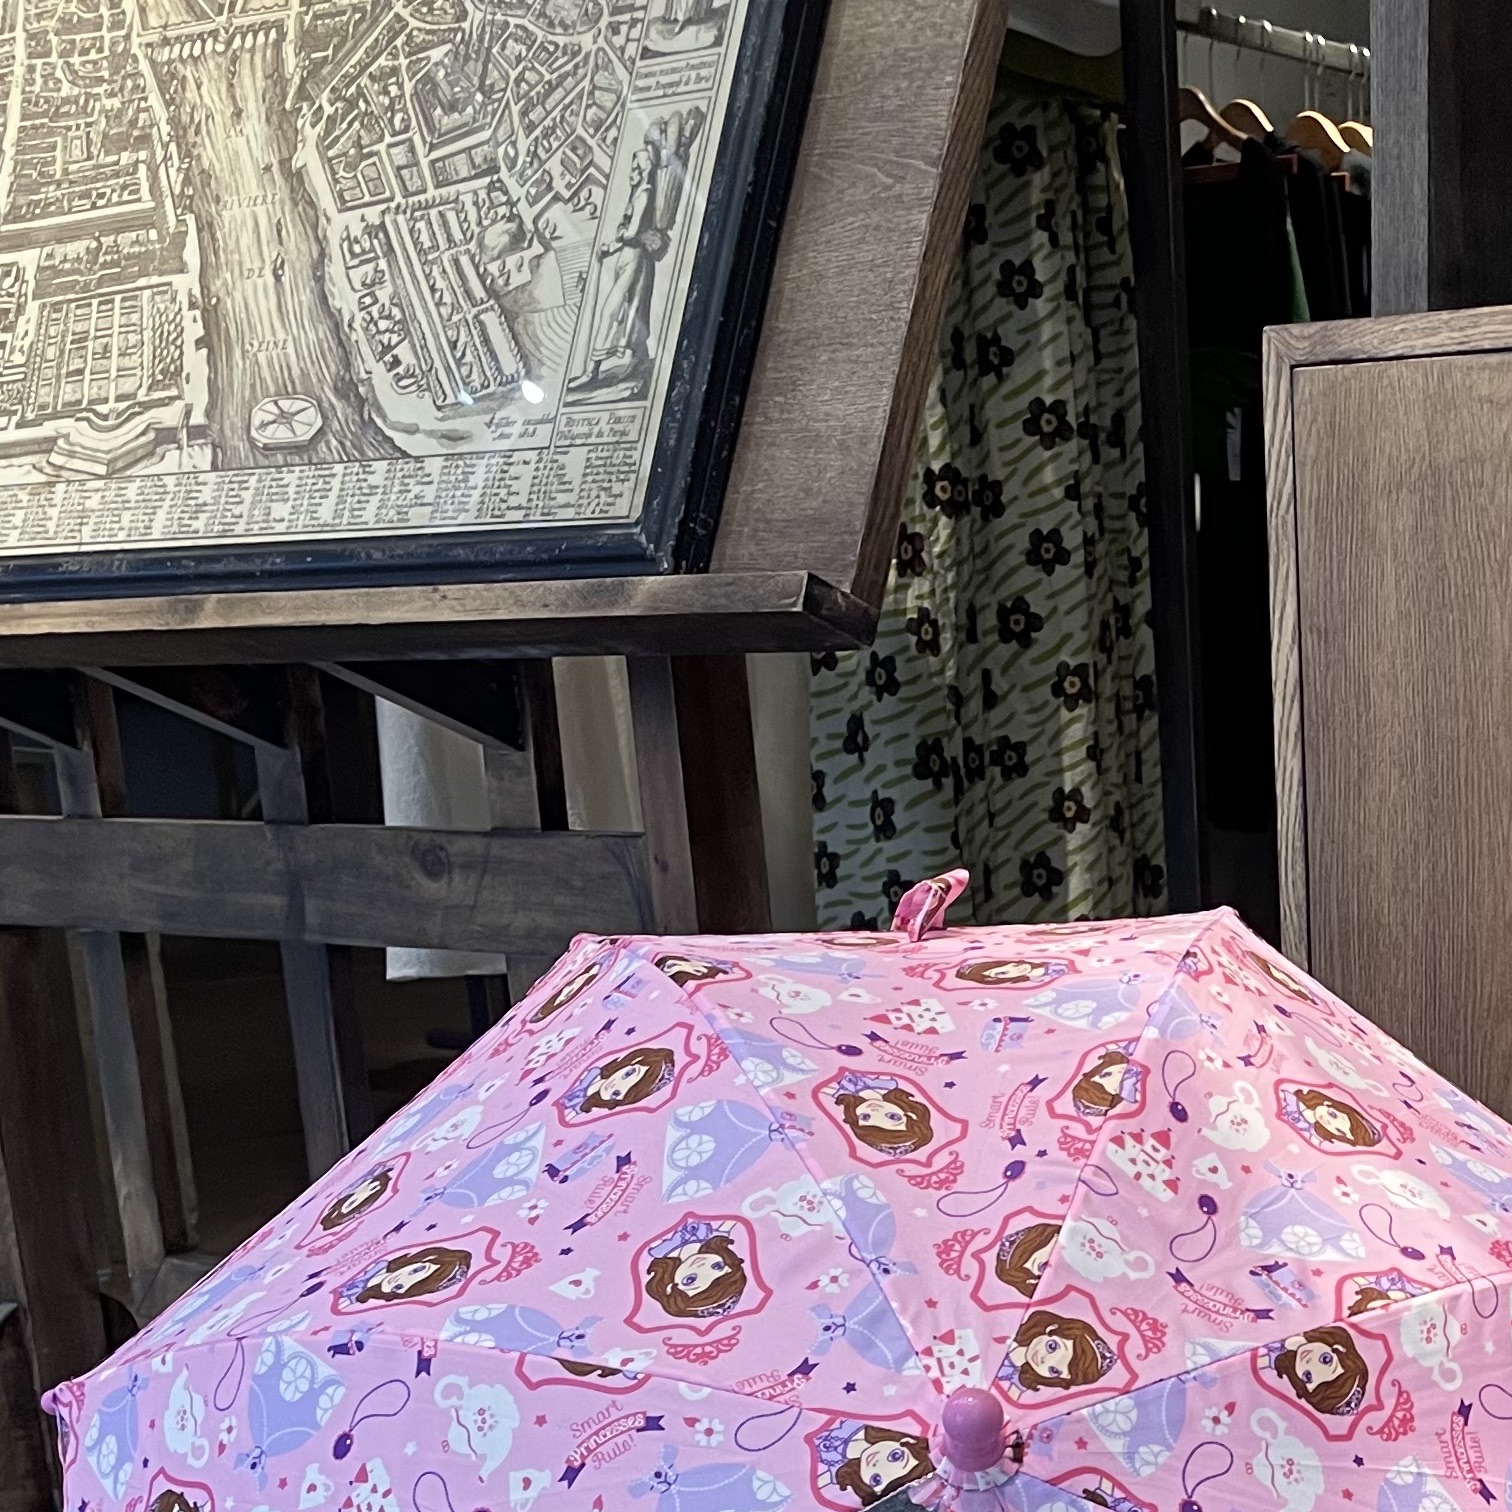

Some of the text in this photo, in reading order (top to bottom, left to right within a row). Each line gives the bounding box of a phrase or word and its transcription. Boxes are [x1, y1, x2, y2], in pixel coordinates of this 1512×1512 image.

[877, 1053, 928, 1077] Smart
[614, 1175, 652, 1214] Smart
[1177, 1283, 1256, 1322] Princesses
[1200, 1283, 1245, 1309] Rule!
[1182, 1302, 1234, 1333] Smart
[570, 1400, 623, 1439] Smart
[566, 1413, 645, 1468] Princesses
[592, 1437, 635, 1470] Rule!
[1435, 1430, 1459, 1480] Smart
[1453, 1414, 1480, 1494] Princesses
[1467, 1432, 1488, 1475] Rule!
